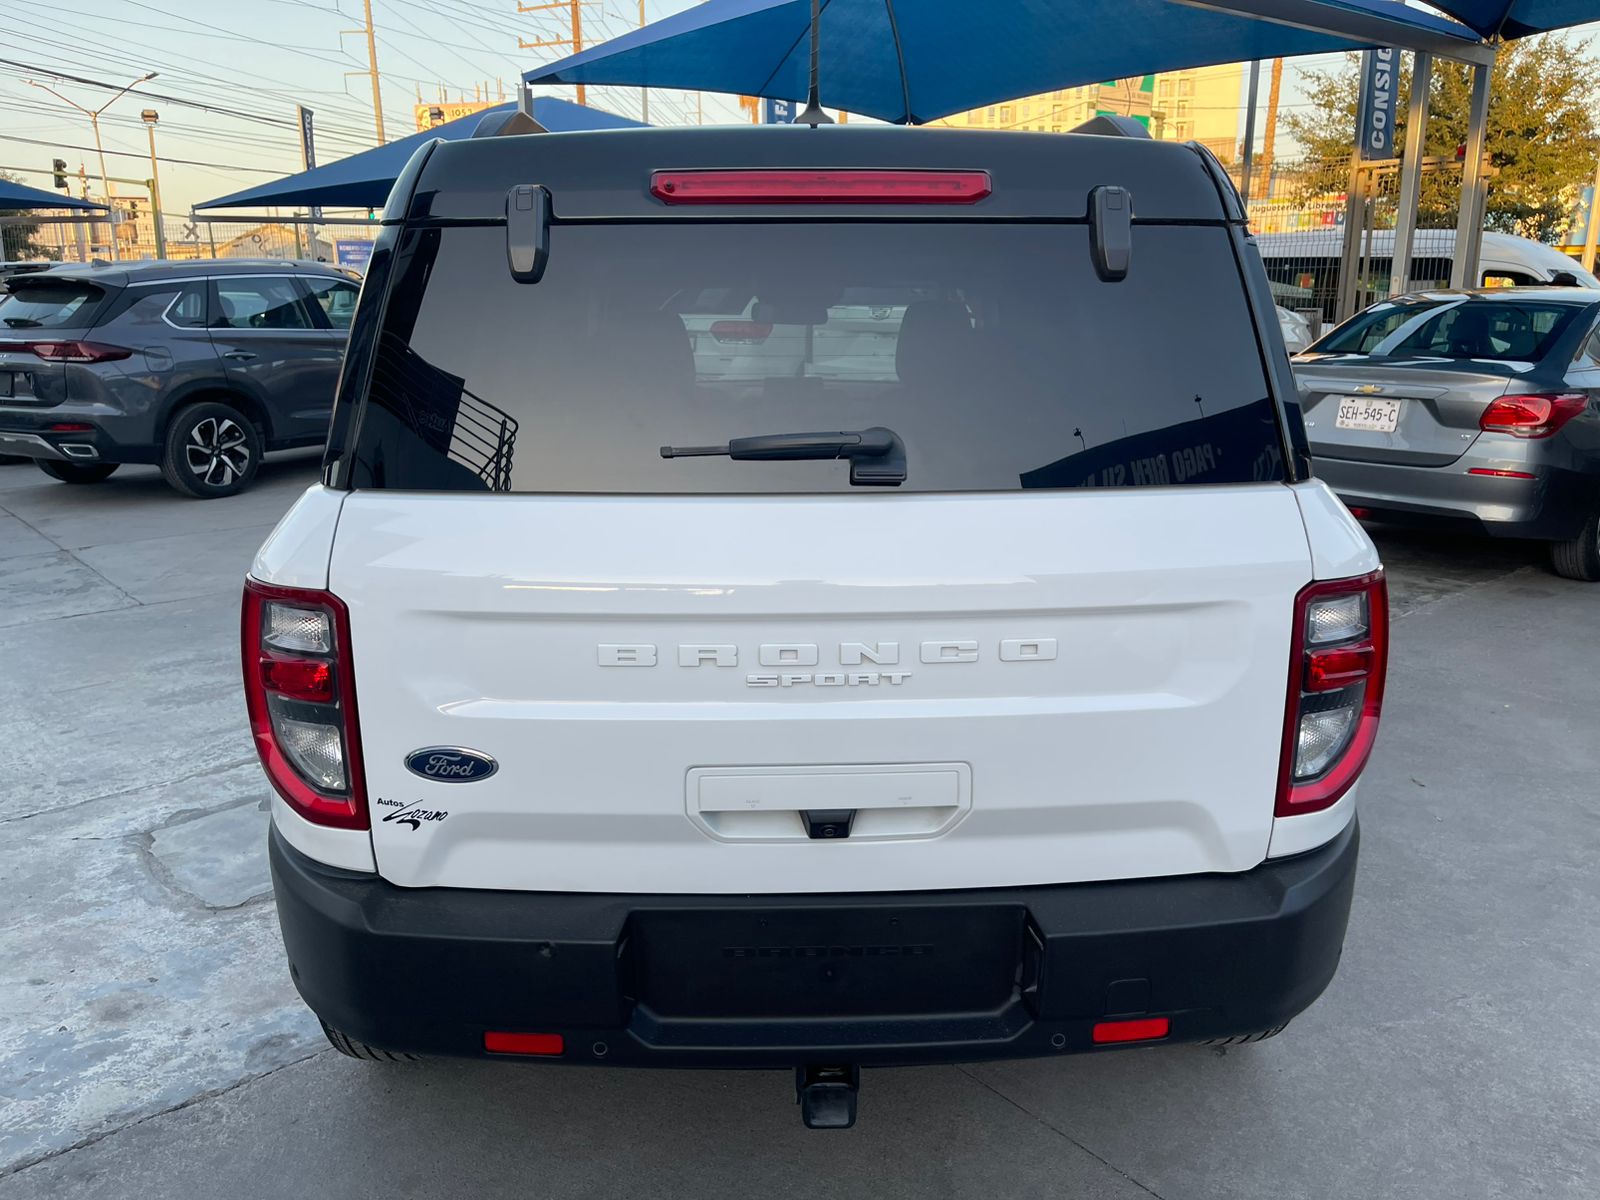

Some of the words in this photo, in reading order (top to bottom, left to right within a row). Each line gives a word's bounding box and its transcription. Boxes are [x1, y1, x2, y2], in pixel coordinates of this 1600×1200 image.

[1339, 406, 1396, 422] SEH-545-C
[597, 638, 1058, 667] BRONCO
[746, 672, 912, 687] SPORT
[425, 754, 474, 776] Ford
[377, 797, 404, 808] Autos
